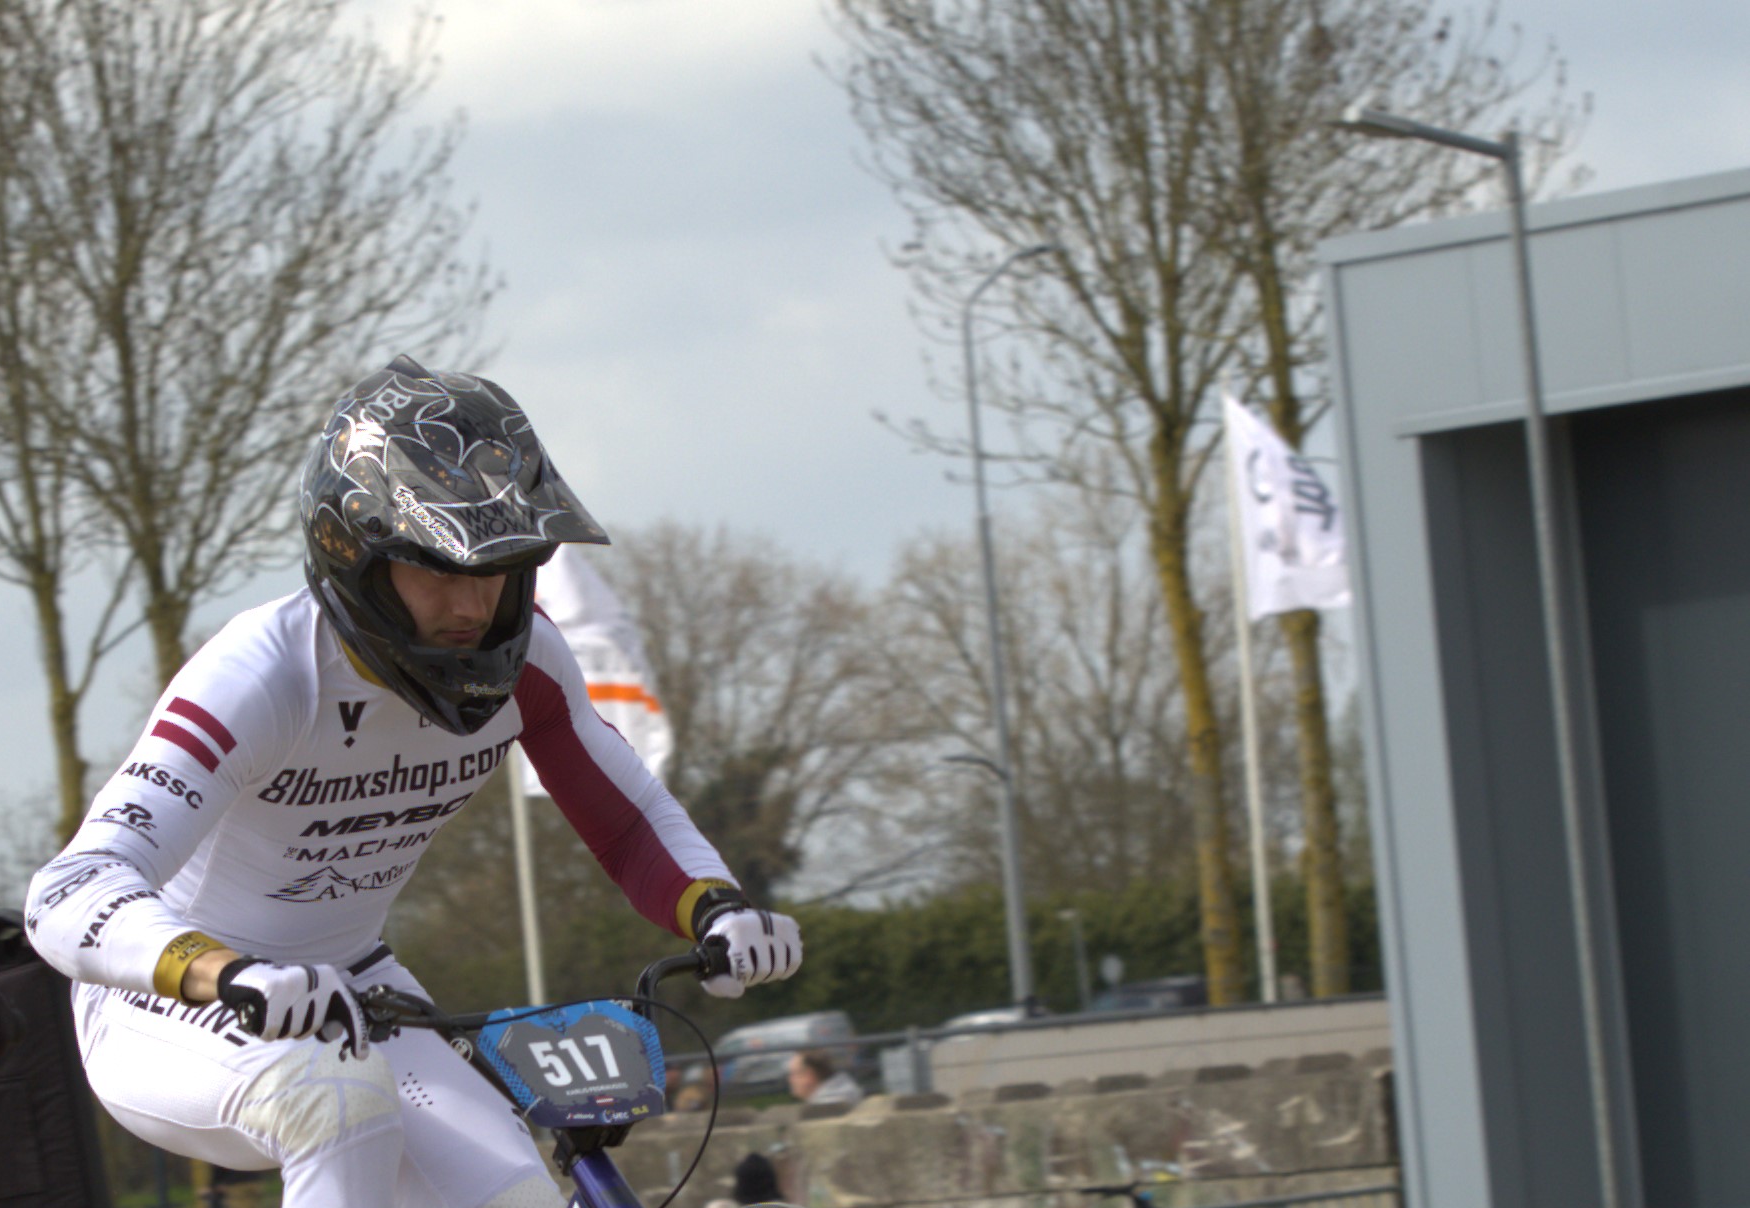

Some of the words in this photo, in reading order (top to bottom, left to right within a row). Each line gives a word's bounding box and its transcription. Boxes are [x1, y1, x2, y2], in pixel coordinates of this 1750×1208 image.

[121, 762, 204, 810] AKSSC
[295, 828, 438, 862] MACHIN
[527, 1033, 621, 1087] 517
